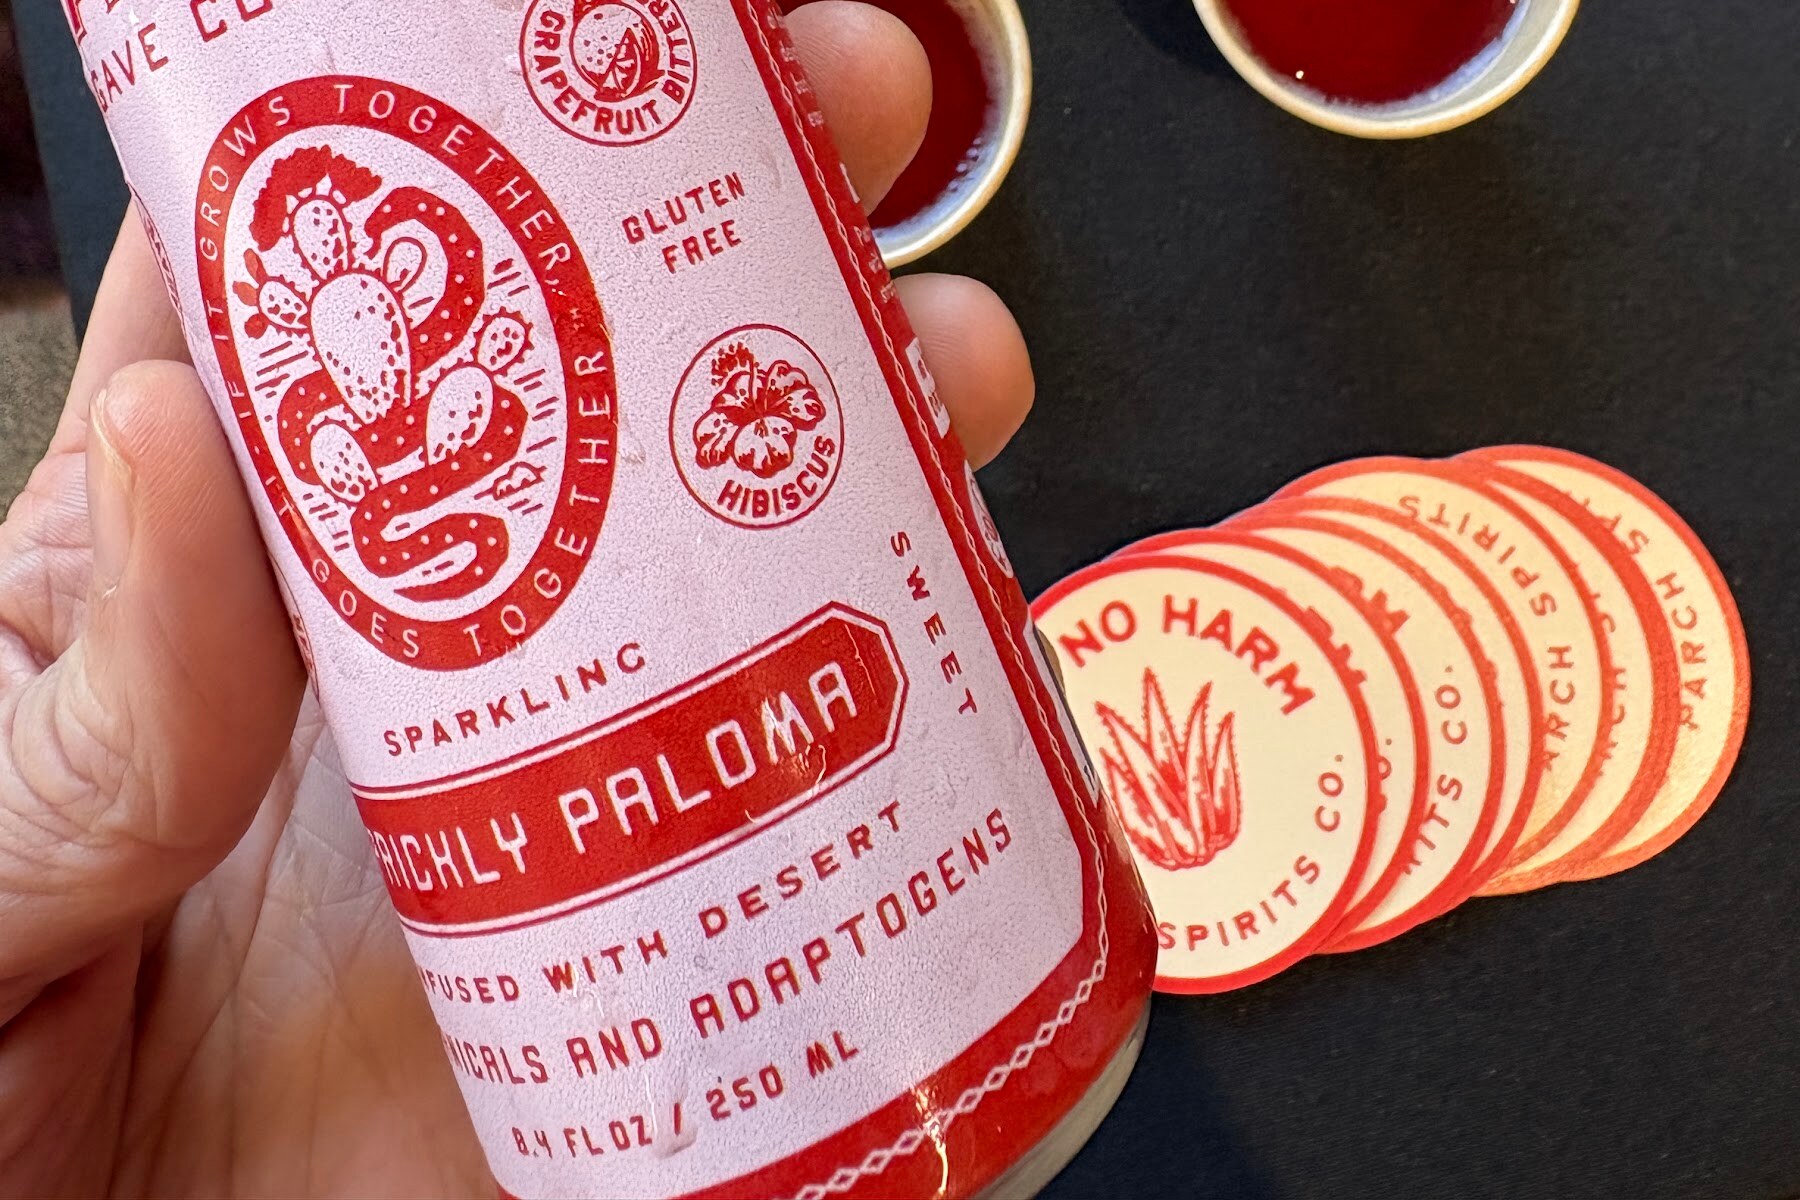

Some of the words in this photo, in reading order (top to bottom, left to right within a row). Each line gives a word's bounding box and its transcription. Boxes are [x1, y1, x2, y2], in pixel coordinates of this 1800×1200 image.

[90, 22, 169, 114] GAVE
[533, 9, 662, 135] GRAPEFRUIT
[200, 95, 291, 262] GROWS
[621, 171, 746, 246] GLUTEN
[661, 218, 743, 274] FREE
[265, 475, 298, 517] IT
[312, 558, 420, 659] GOES
[463, 349, 610, 657] TOGETHER
[717, 434, 836, 518] HIBISCUS
[1398, 495, 1557, 617] SPIRITS
[890, 530, 977, 715] SWEET
[1059, 599, 1137, 668] NO
[1162, 594, 1316, 716] HARM
[382, 641, 646, 757] SPARKLING
[1435, 665, 1468, 746] CO.
[367, 812, 528, 891] RICKLY
[557, 660, 858, 856] PALOMA
[541, 930, 669, 995] WITH
[698, 800, 903, 940] DESERT
[1158, 855, 1320, 951] SPIRITS
[1314, 754, 1344, 832] CO.
[566, 1018, 662, 1078] AND
[688, 807, 1013, 1039] ADAPTOGENS
[511, 1125, 553, 1159] 8.4
[705, 1065, 786, 1121] 250
[805, 1031, 859, 1077] ML
